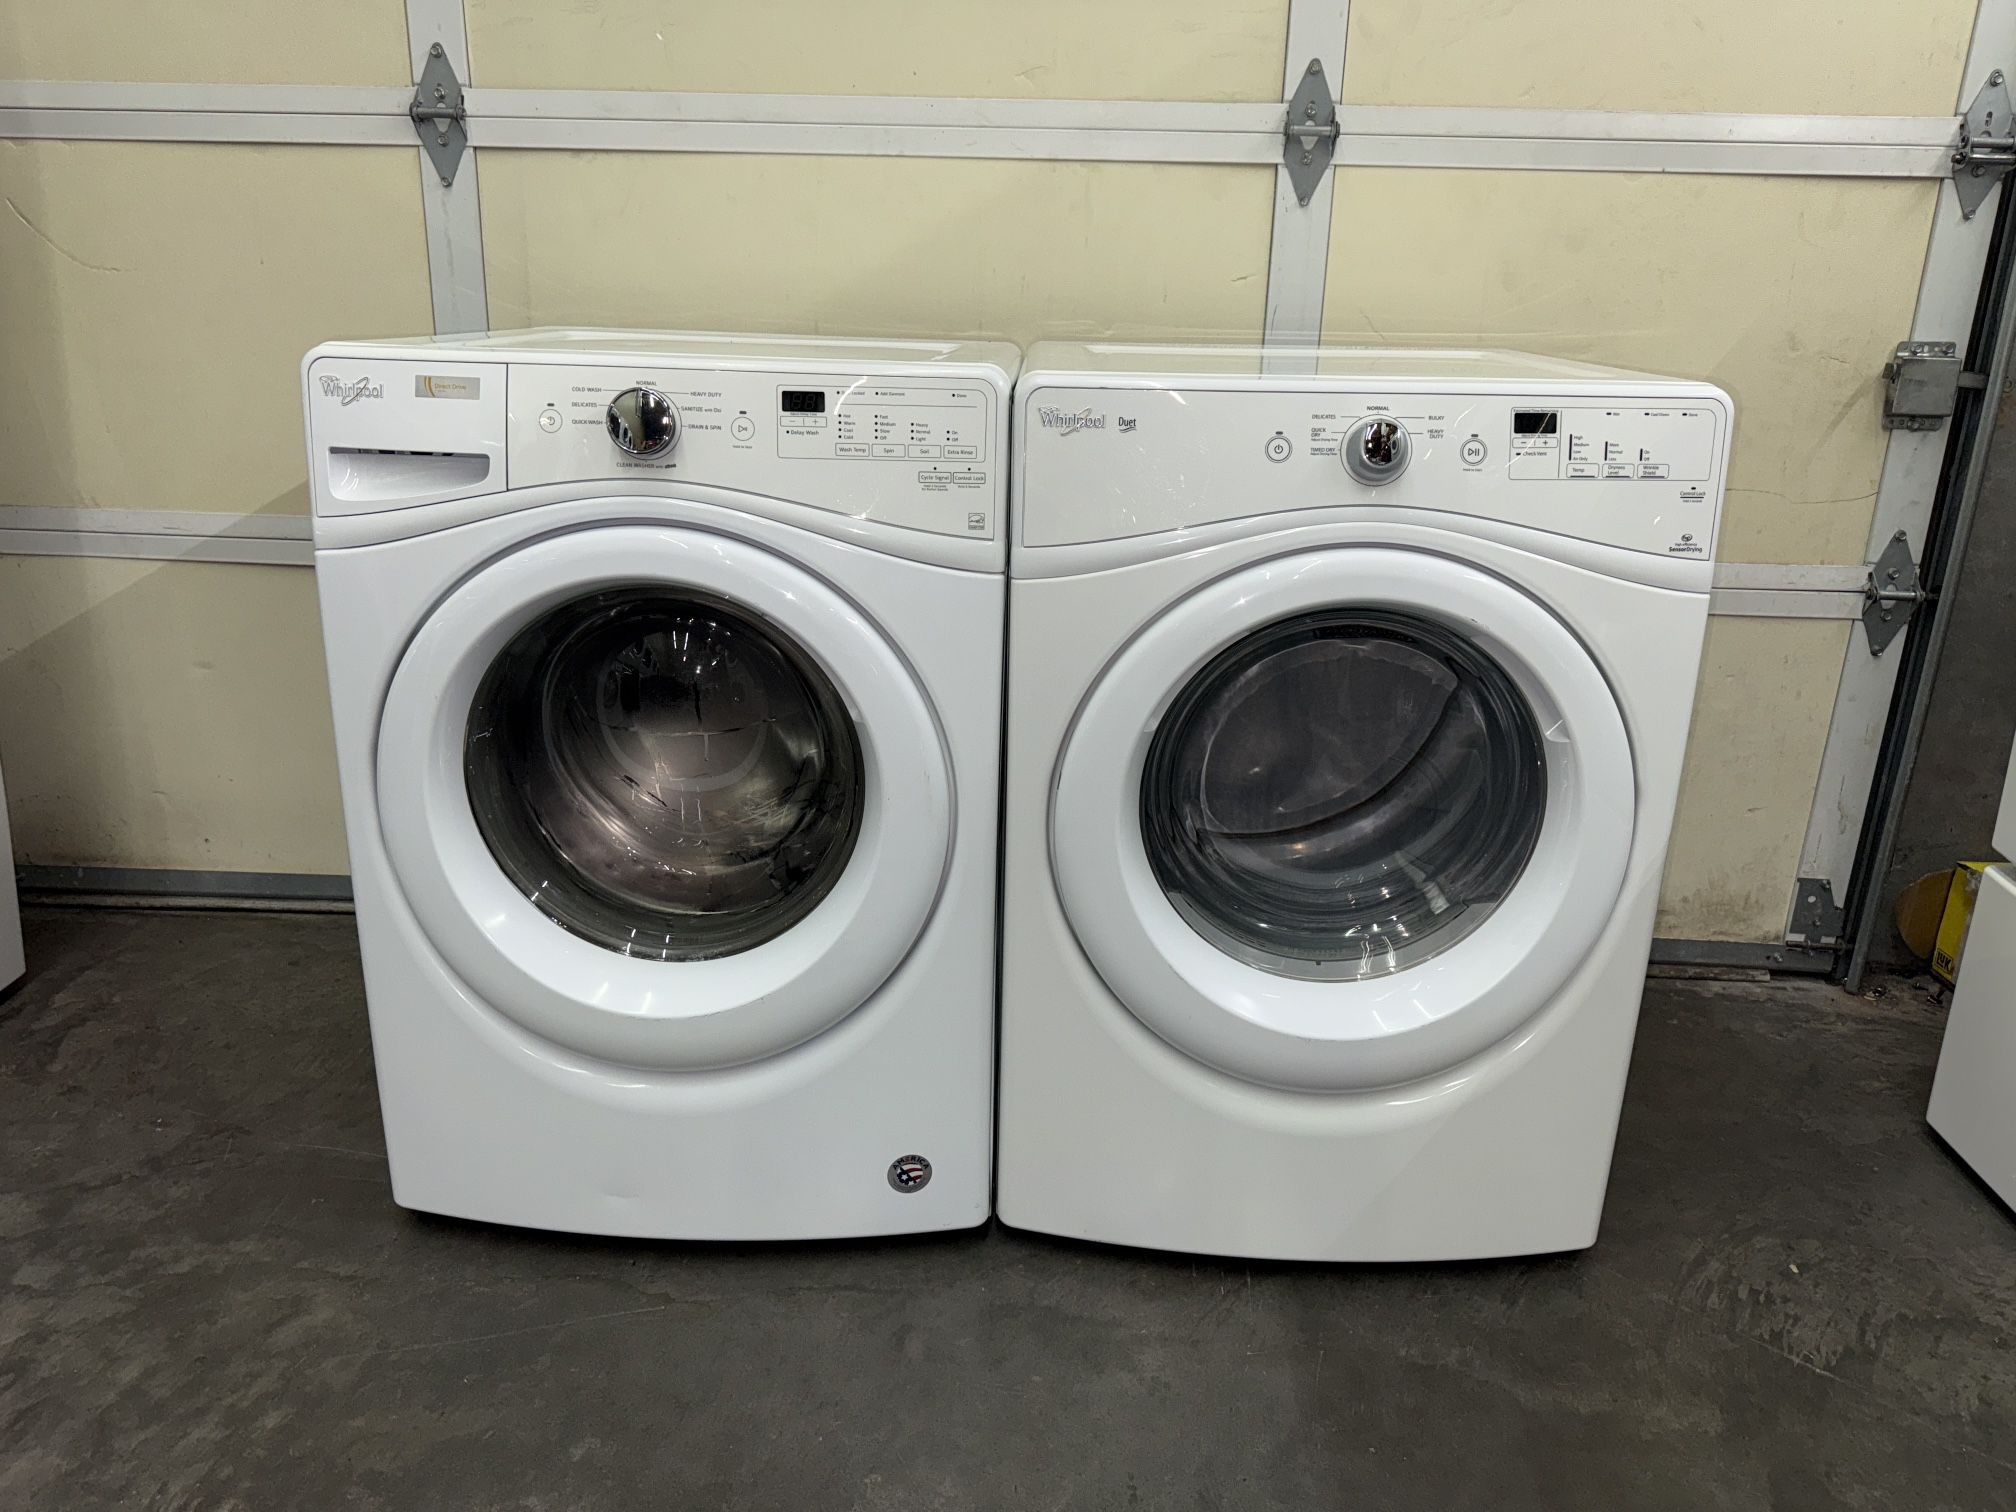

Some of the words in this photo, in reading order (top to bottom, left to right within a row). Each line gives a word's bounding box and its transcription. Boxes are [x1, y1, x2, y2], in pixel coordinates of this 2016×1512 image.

[321, 378, 384, 402] Whirlpool
[1039, 408, 1105, 432] Whirlpool
[1119, 417, 1136, 426] Duet
[893, 1156, 929, 1170] AMERICA
